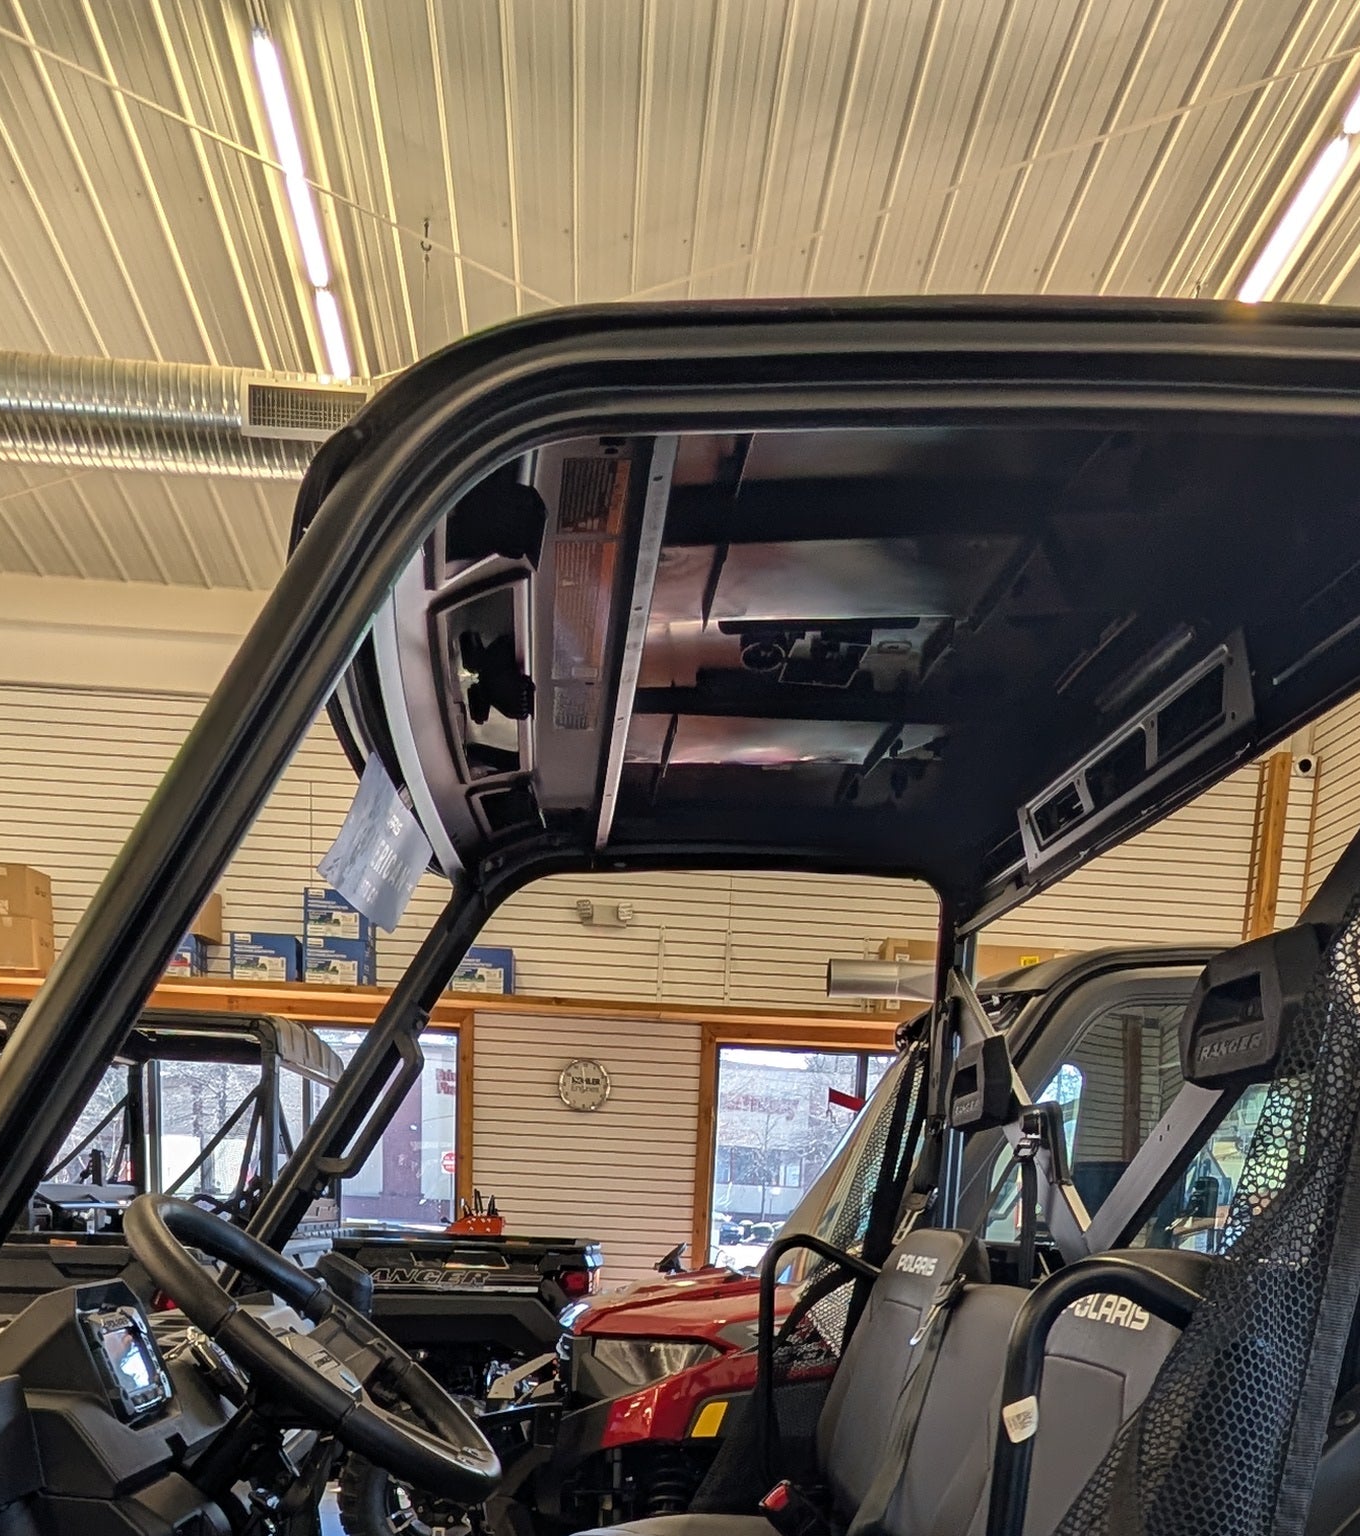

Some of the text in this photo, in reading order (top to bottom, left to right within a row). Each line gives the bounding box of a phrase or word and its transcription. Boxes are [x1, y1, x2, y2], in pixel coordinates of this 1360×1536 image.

[1197, 1031, 1263, 1062] RANGER
[370, 1268, 490, 1285] ANGER
[896, 1254, 938, 1277] POLARIS
